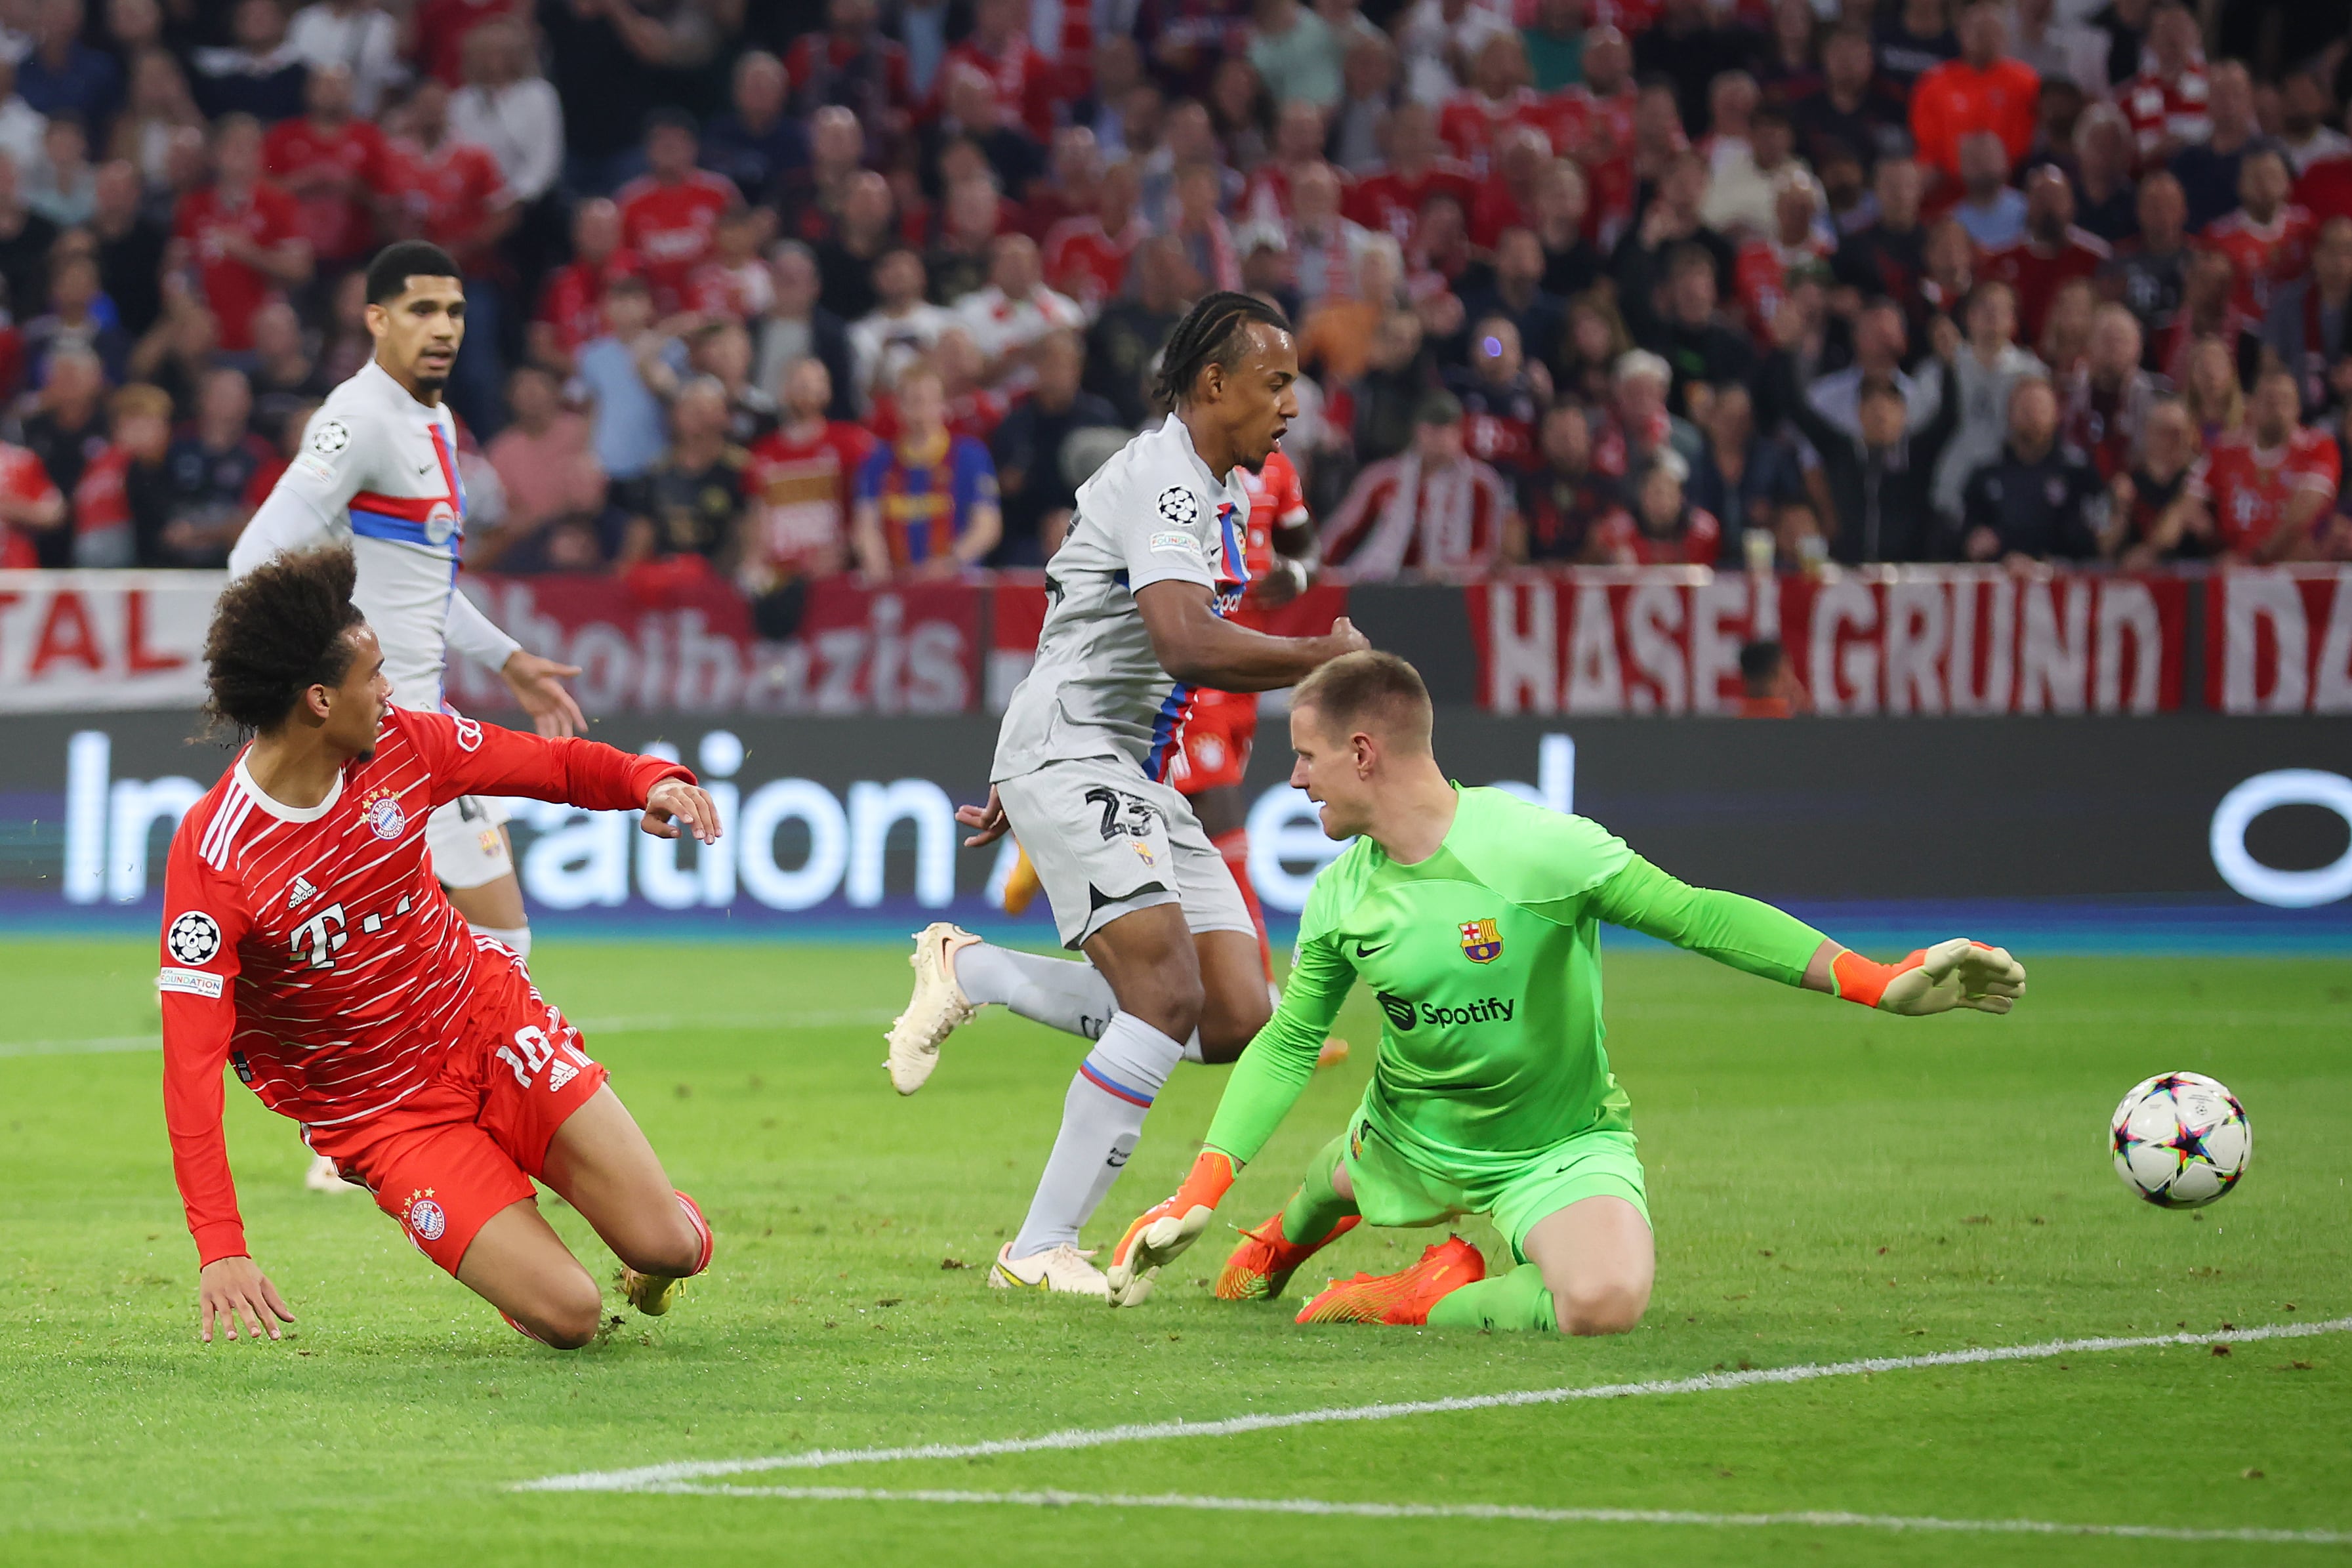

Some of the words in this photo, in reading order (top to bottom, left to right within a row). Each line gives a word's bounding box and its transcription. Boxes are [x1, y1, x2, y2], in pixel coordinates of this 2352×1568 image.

[375, 801, 398, 813] BAYERN
[288, 886, 318, 909] adidas
[1421, 997, 1514, 1029] Spotify
[549, 1067, 580, 1092] adidas
[413, 1203, 433, 1220] BAYERN
